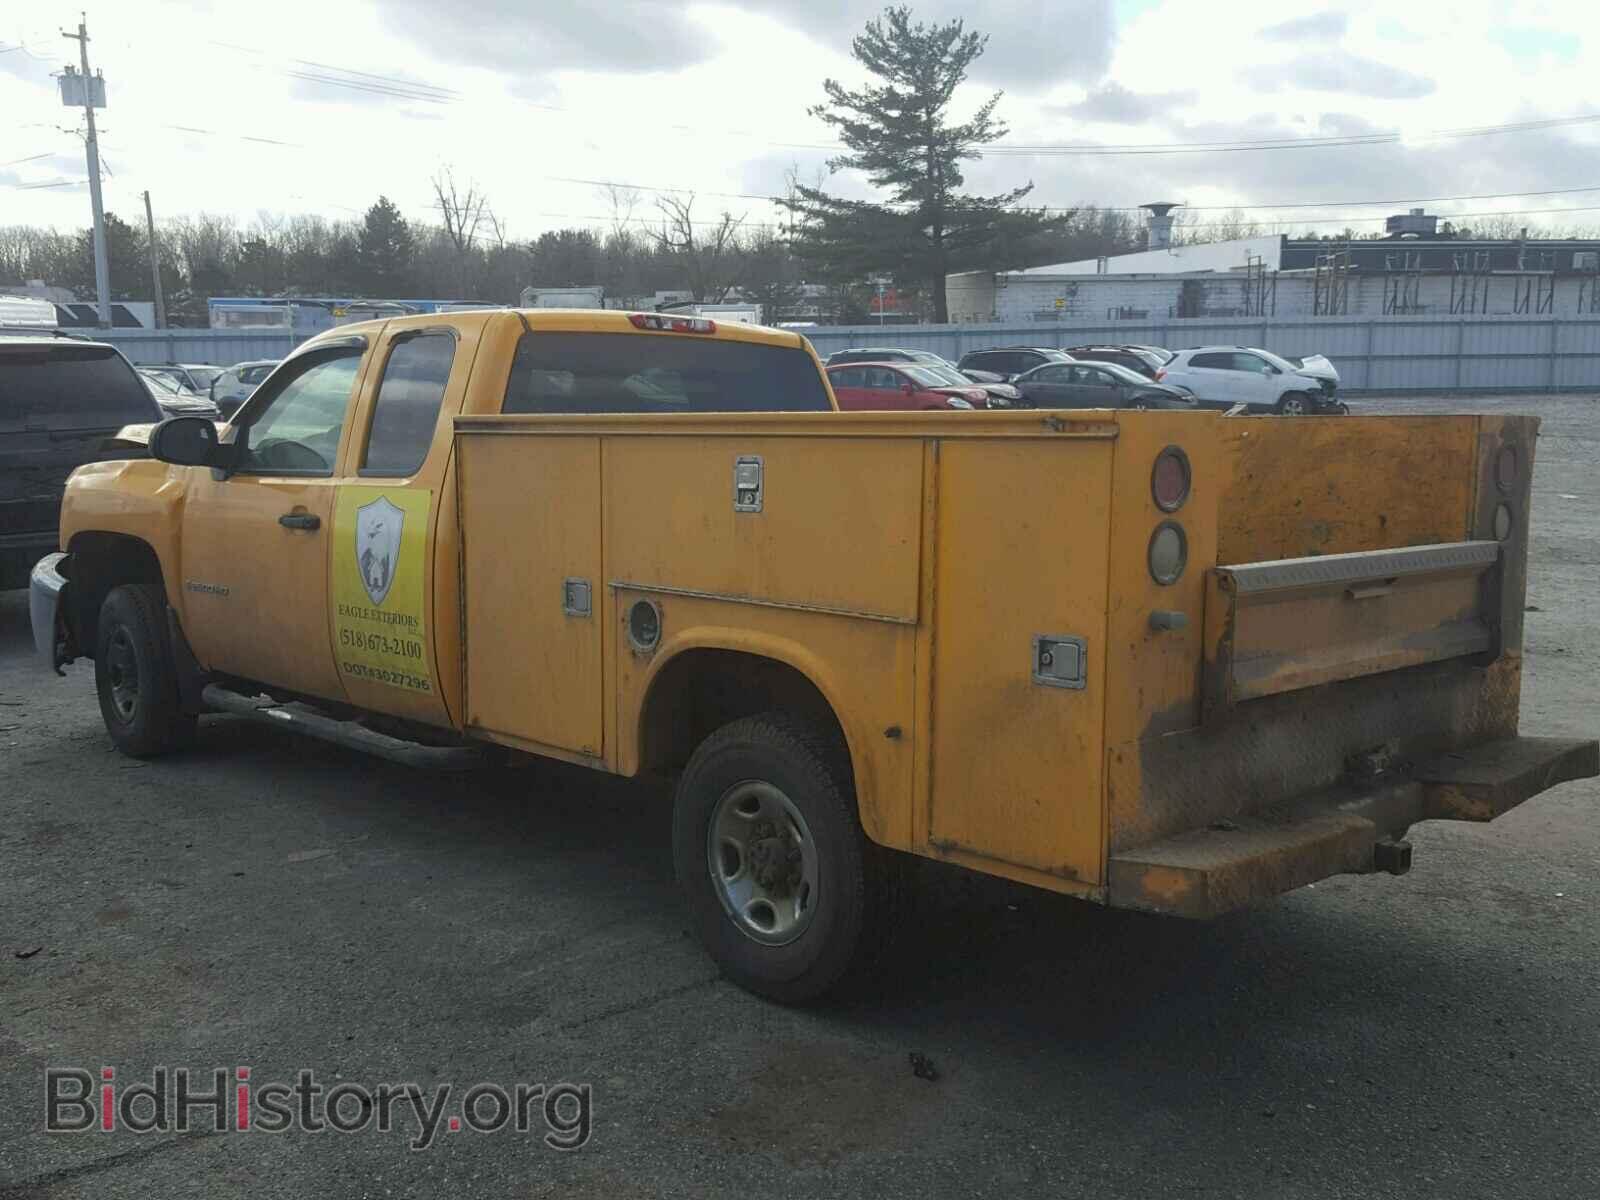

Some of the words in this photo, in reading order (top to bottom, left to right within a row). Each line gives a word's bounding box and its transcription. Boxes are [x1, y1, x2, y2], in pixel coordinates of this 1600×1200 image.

[338, 604, 369, 619] EAGLE
[371, 609, 418, 626] EXTERIORS
[340, 628, 421, 660] (518)673-2100
